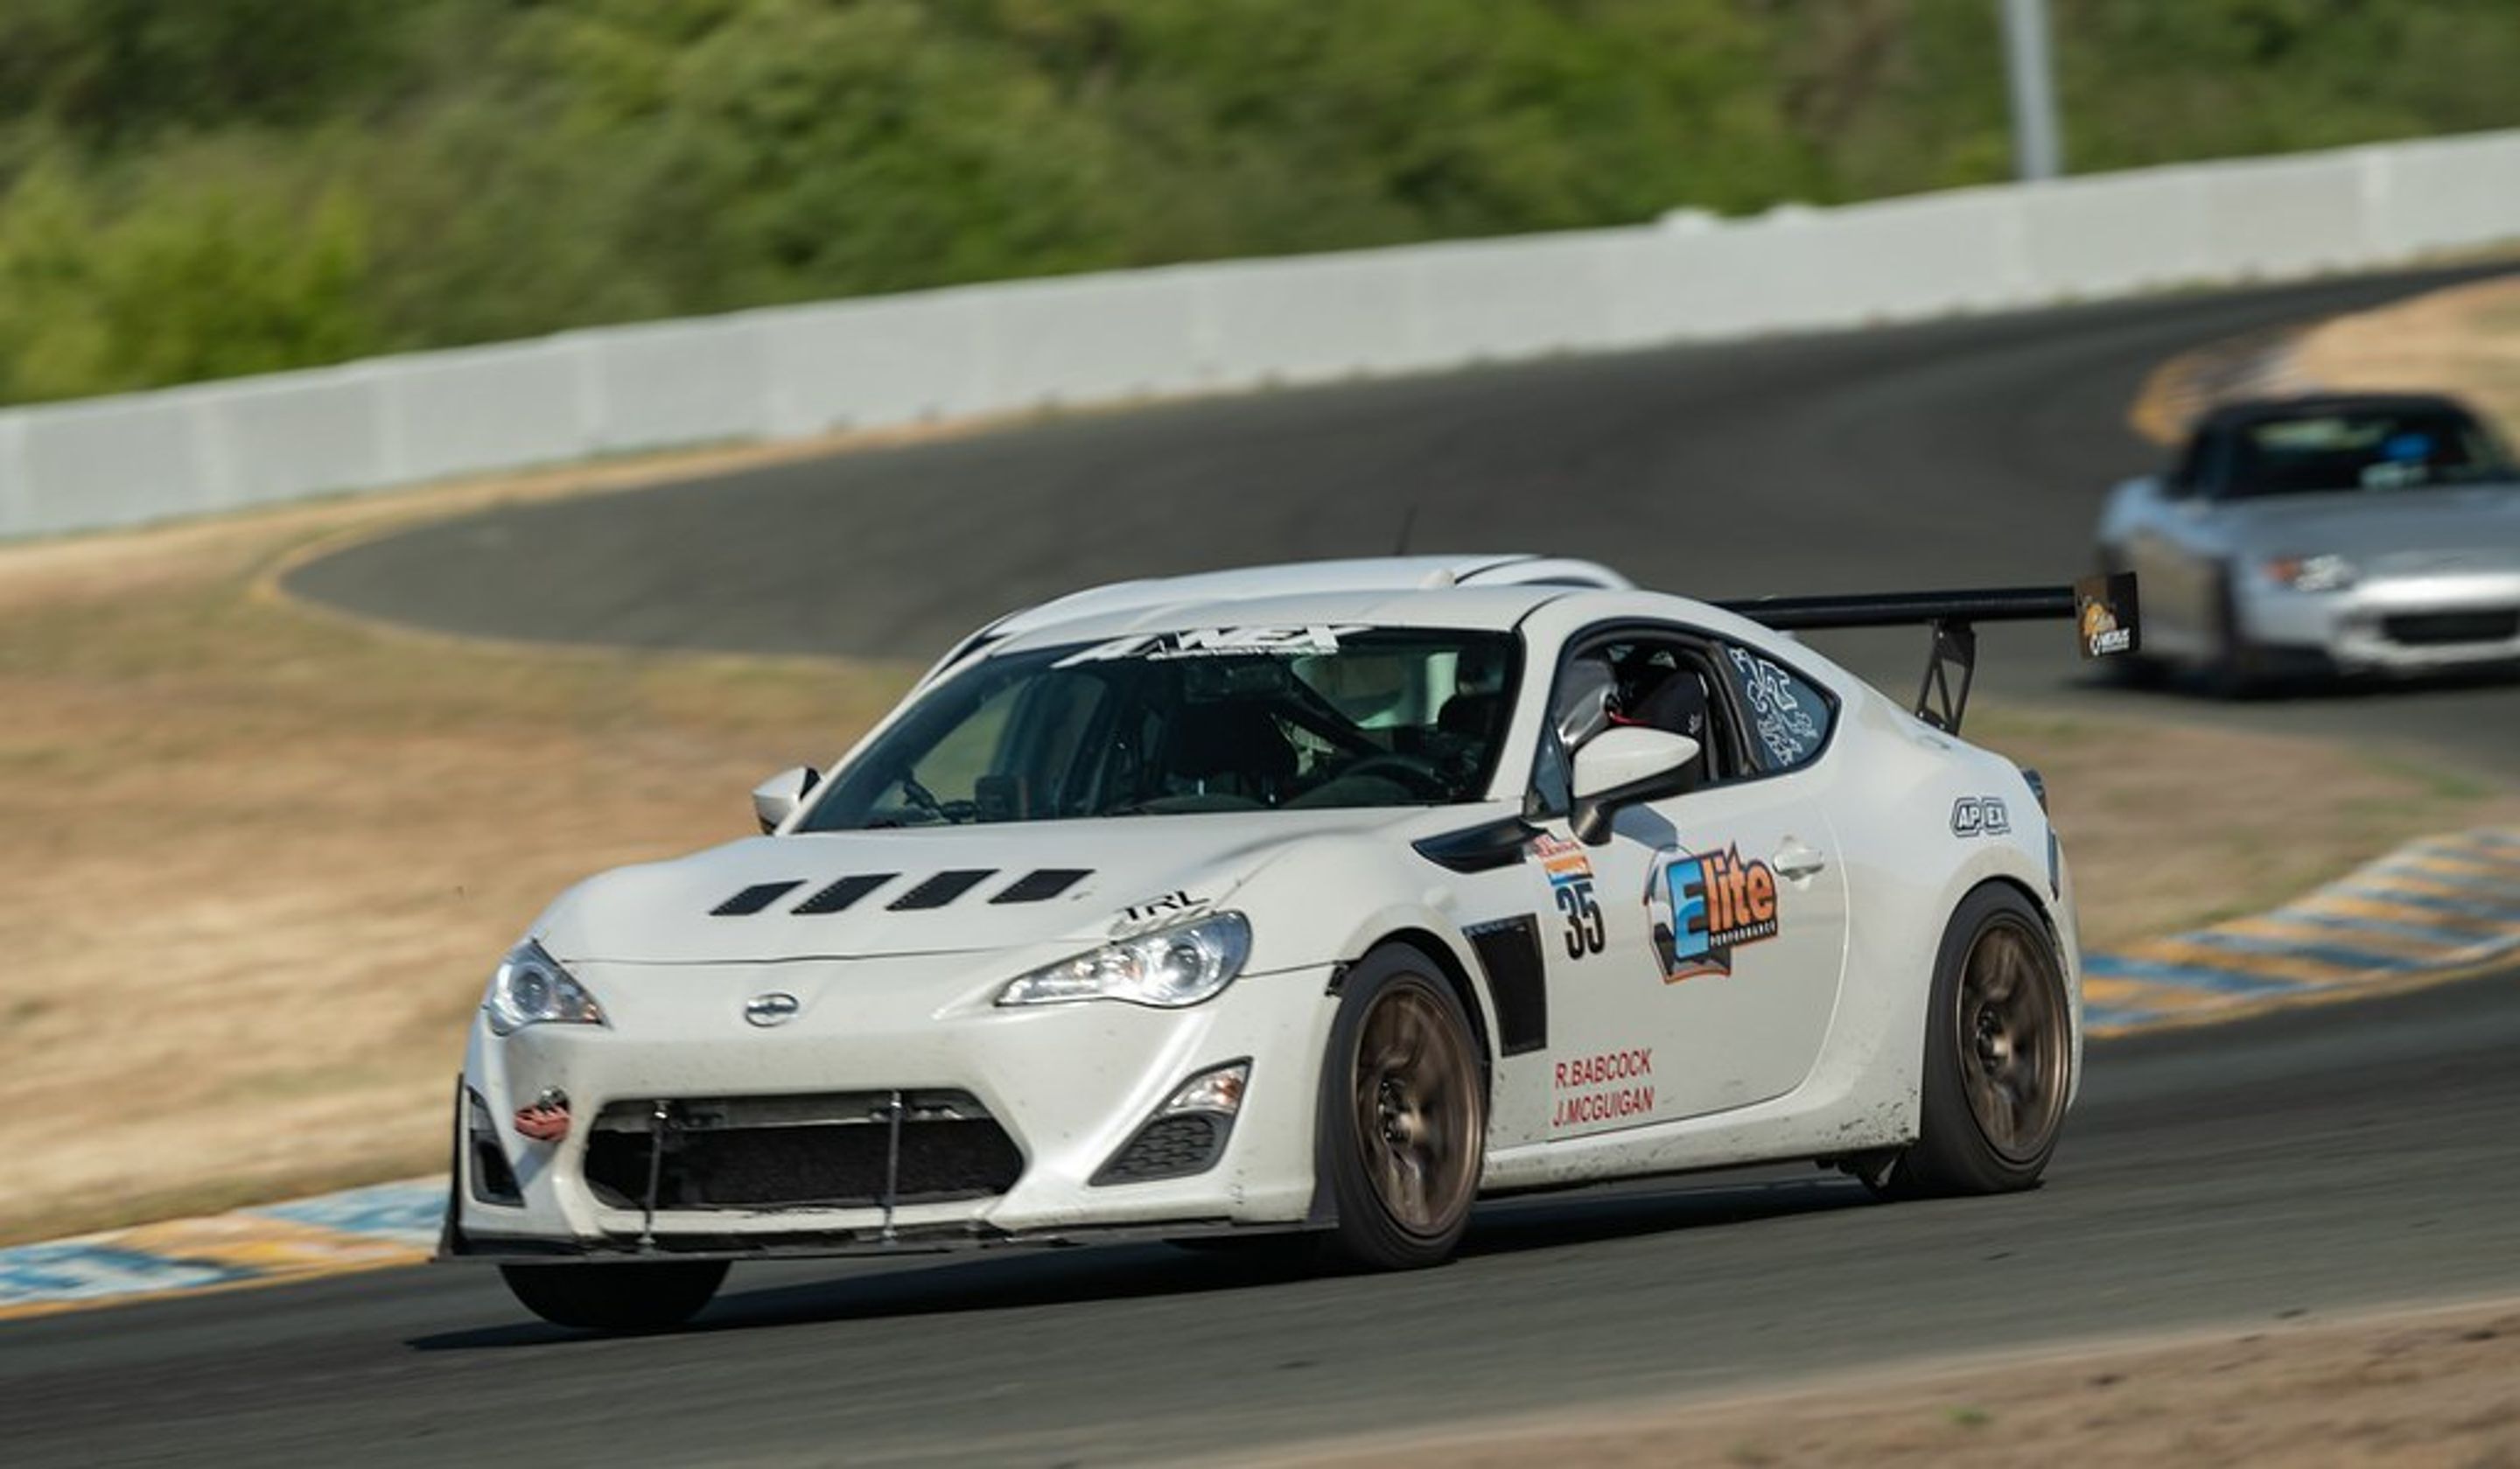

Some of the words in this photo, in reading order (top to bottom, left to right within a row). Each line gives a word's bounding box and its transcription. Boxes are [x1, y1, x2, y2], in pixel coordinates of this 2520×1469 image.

[1113, 890, 1211, 921] TRL
[1555, 881, 1606, 960] 35
[1669, 846, 1774, 959] Elite
[1555, 1048, 1652, 1088] R.BABCOCK
[1553, 1086, 1655, 1128] J.MCGUIGAN
